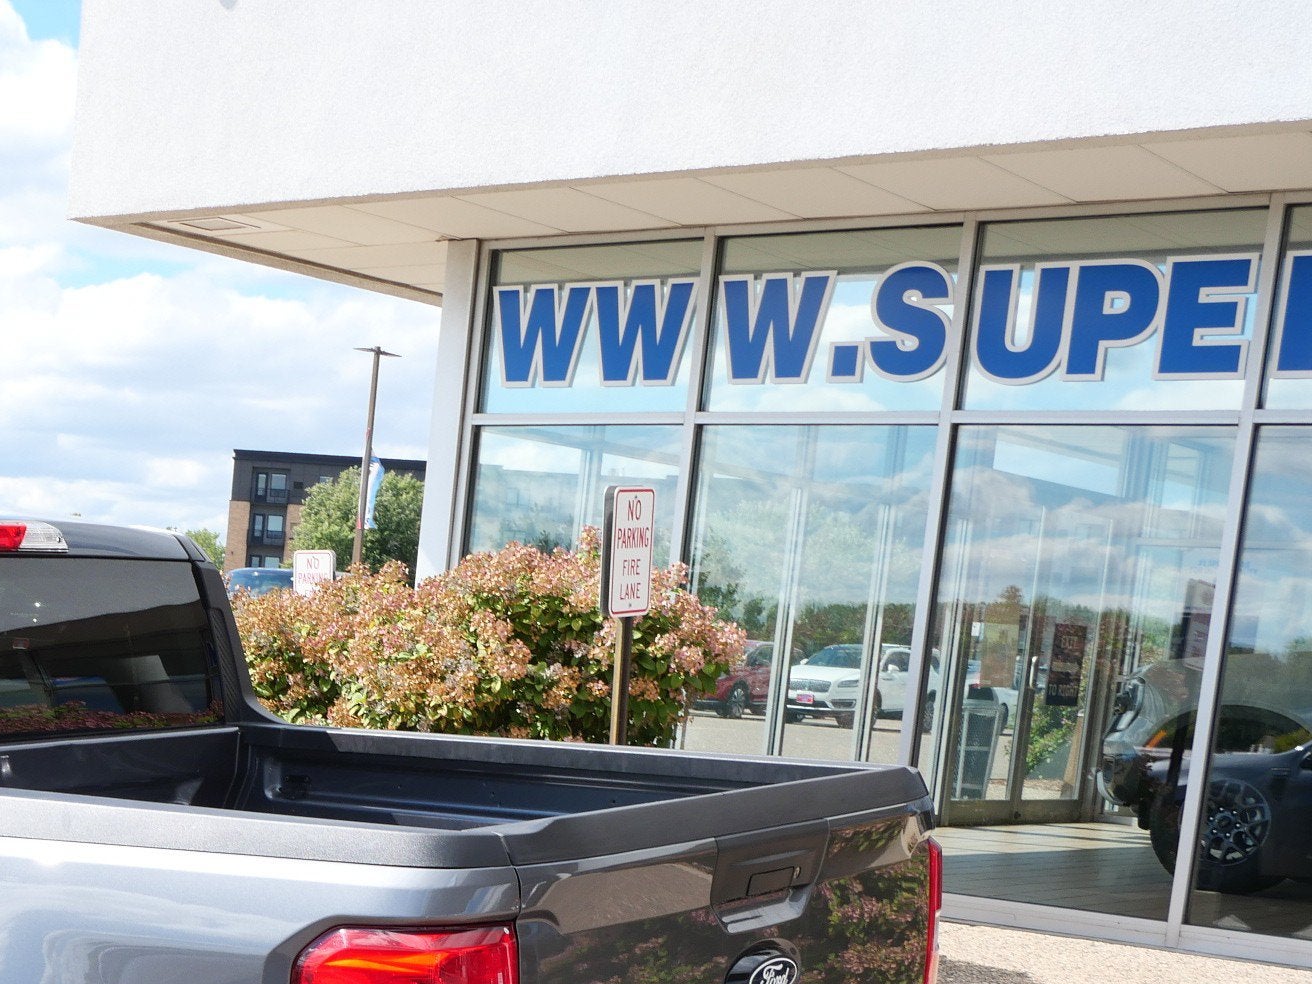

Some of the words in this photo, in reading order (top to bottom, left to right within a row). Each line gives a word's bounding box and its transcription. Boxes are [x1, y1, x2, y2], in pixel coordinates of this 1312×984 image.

[492, 252, 1312, 388] WWW.SUPE
[627, 499, 642, 521] NO
[616, 526, 649, 550] PARKING
[306, 557, 320, 570] NO
[622, 558, 641, 577] FIRE
[619, 582, 641, 601] LANE
